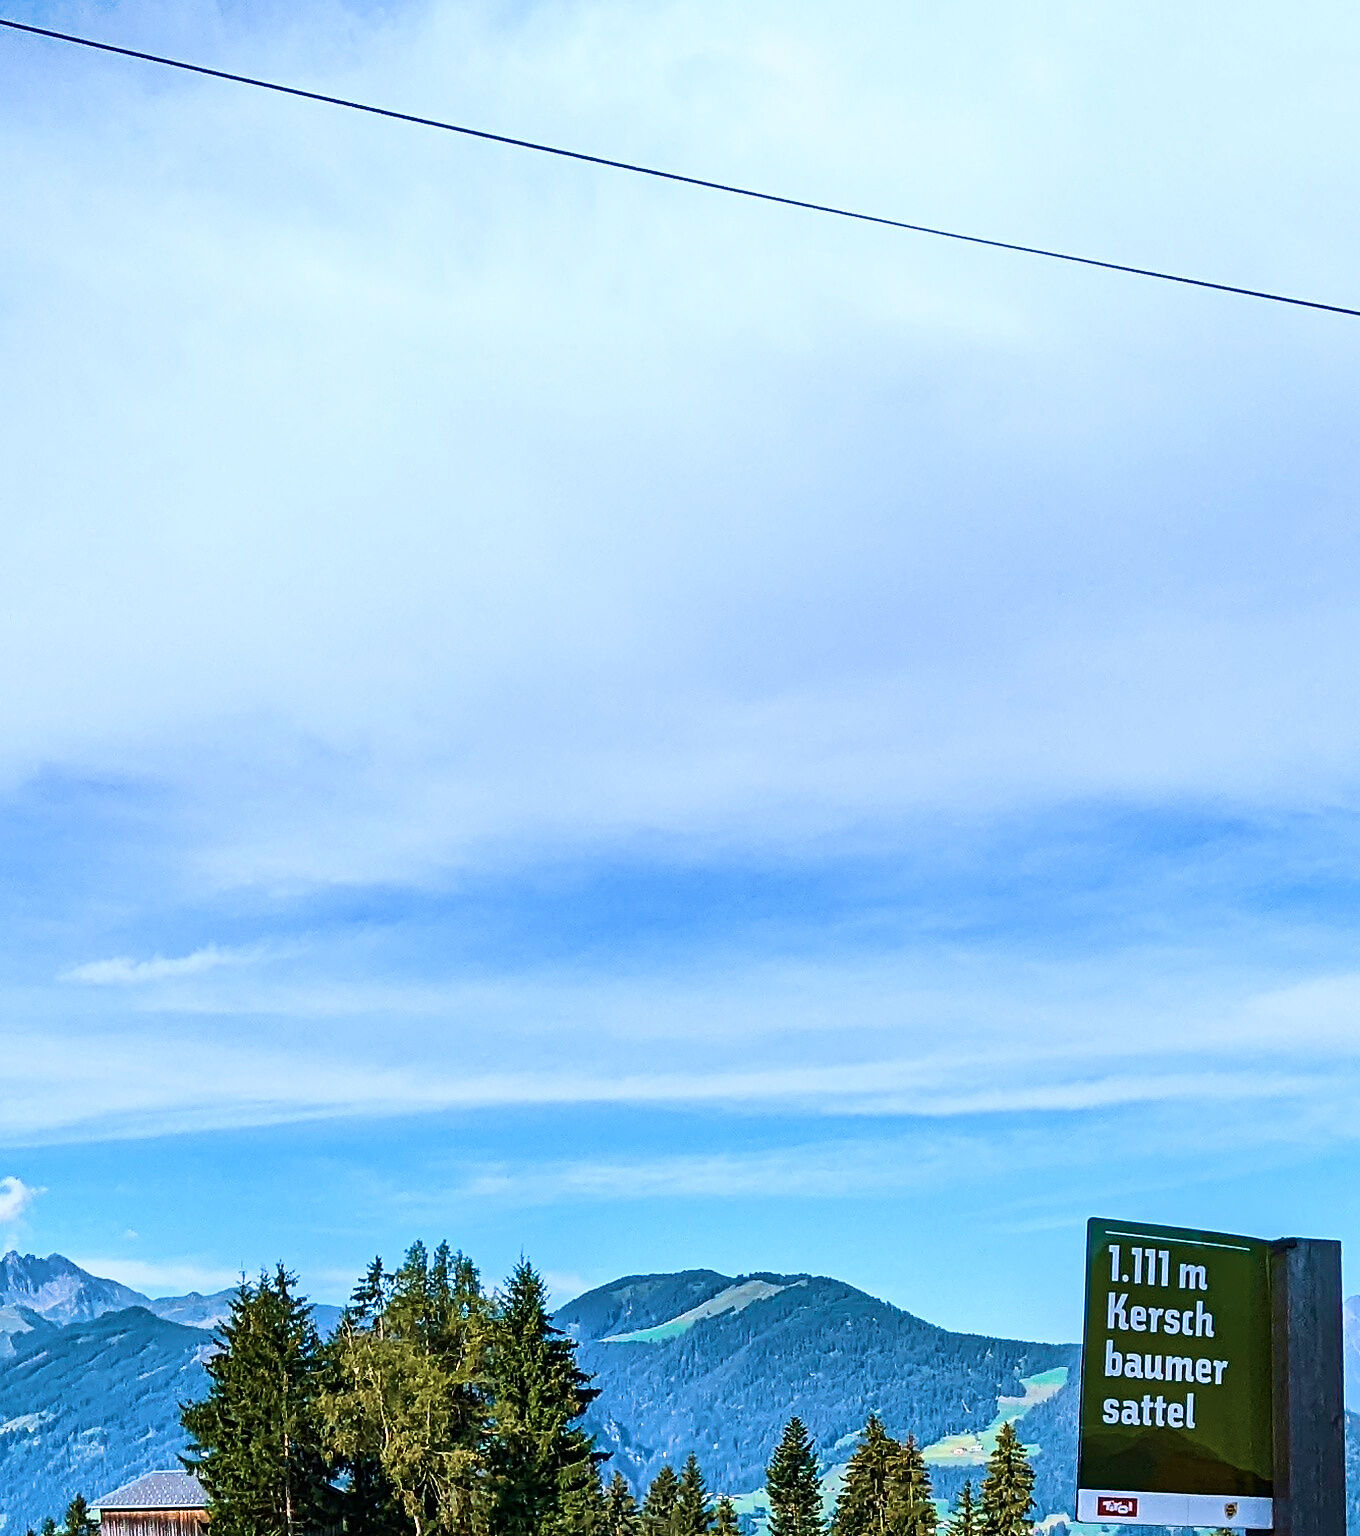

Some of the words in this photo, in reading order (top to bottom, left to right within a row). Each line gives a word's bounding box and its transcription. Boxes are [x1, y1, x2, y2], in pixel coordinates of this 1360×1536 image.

[1108, 1245, 1170, 1287] 1.111
[1179, 1261, 1208, 1291] m
[1106, 1292, 1215, 1338] Kersch
[1104, 1340, 1229, 1385] baumer
[1102, 1393, 1196, 1429] sattel
